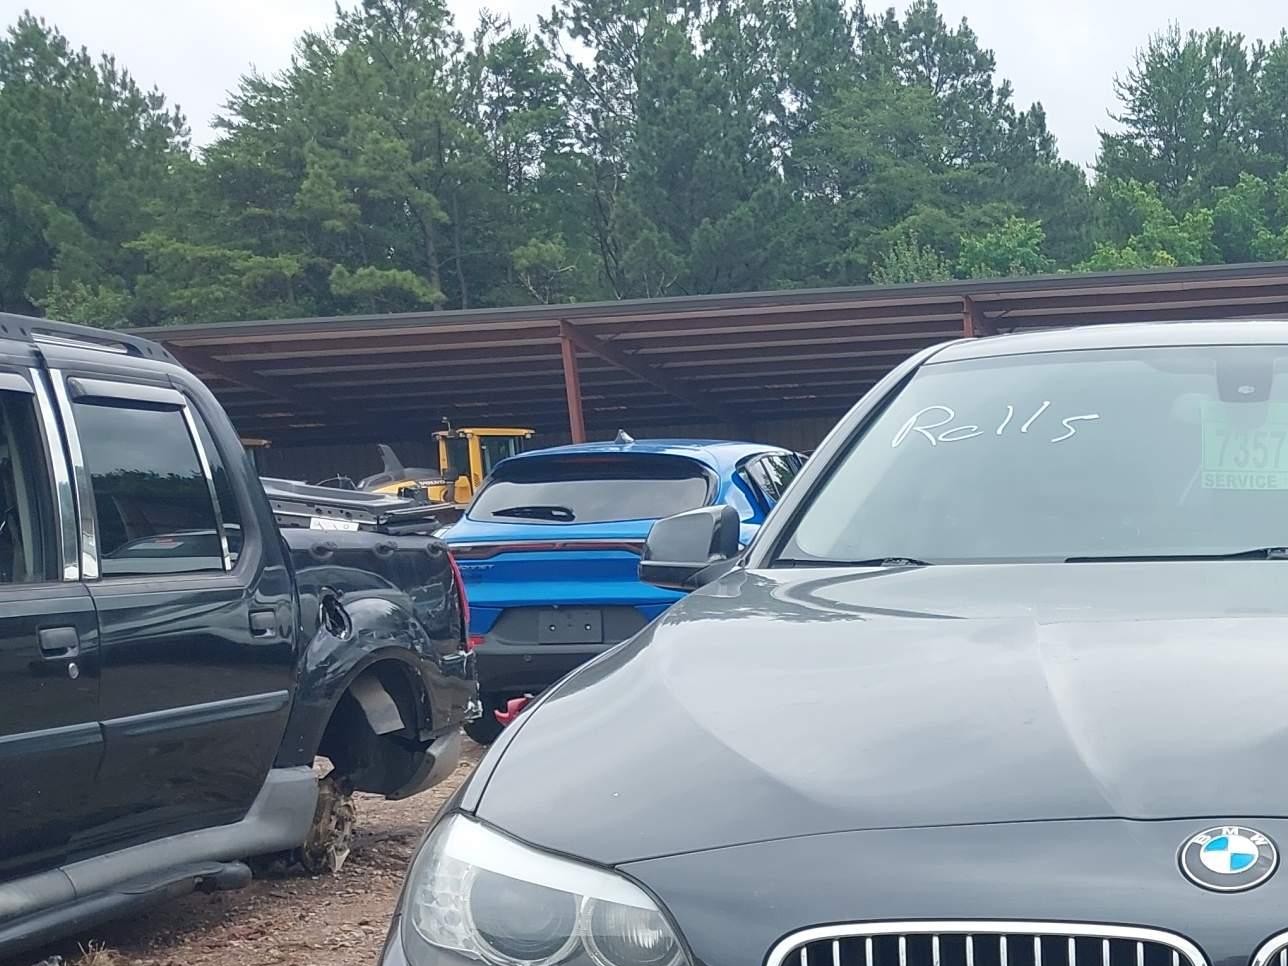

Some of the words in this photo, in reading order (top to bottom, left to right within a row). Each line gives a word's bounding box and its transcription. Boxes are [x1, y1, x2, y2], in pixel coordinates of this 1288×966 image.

[1215, 430, 1288, 469] 7357
[1204, 473, 1279, 489] SERVICE
[1192, 826, 1269, 846] BMW
